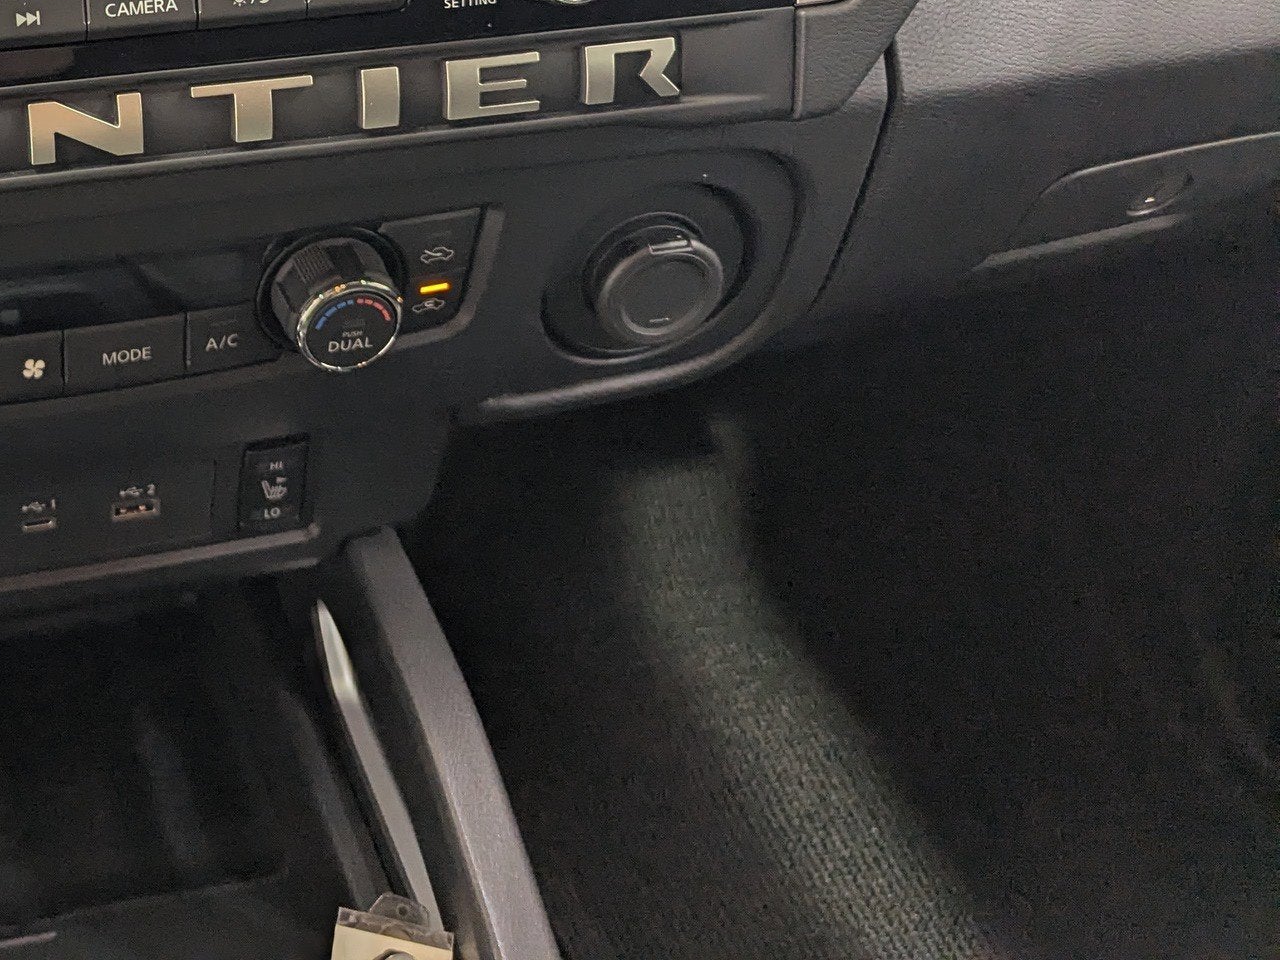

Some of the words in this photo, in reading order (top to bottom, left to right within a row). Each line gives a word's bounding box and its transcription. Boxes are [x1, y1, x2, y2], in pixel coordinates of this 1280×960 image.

[205, 334, 239, 352] A/C
[328, 337, 373, 355] DUAL
[102, 346, 152, 367] MODE
